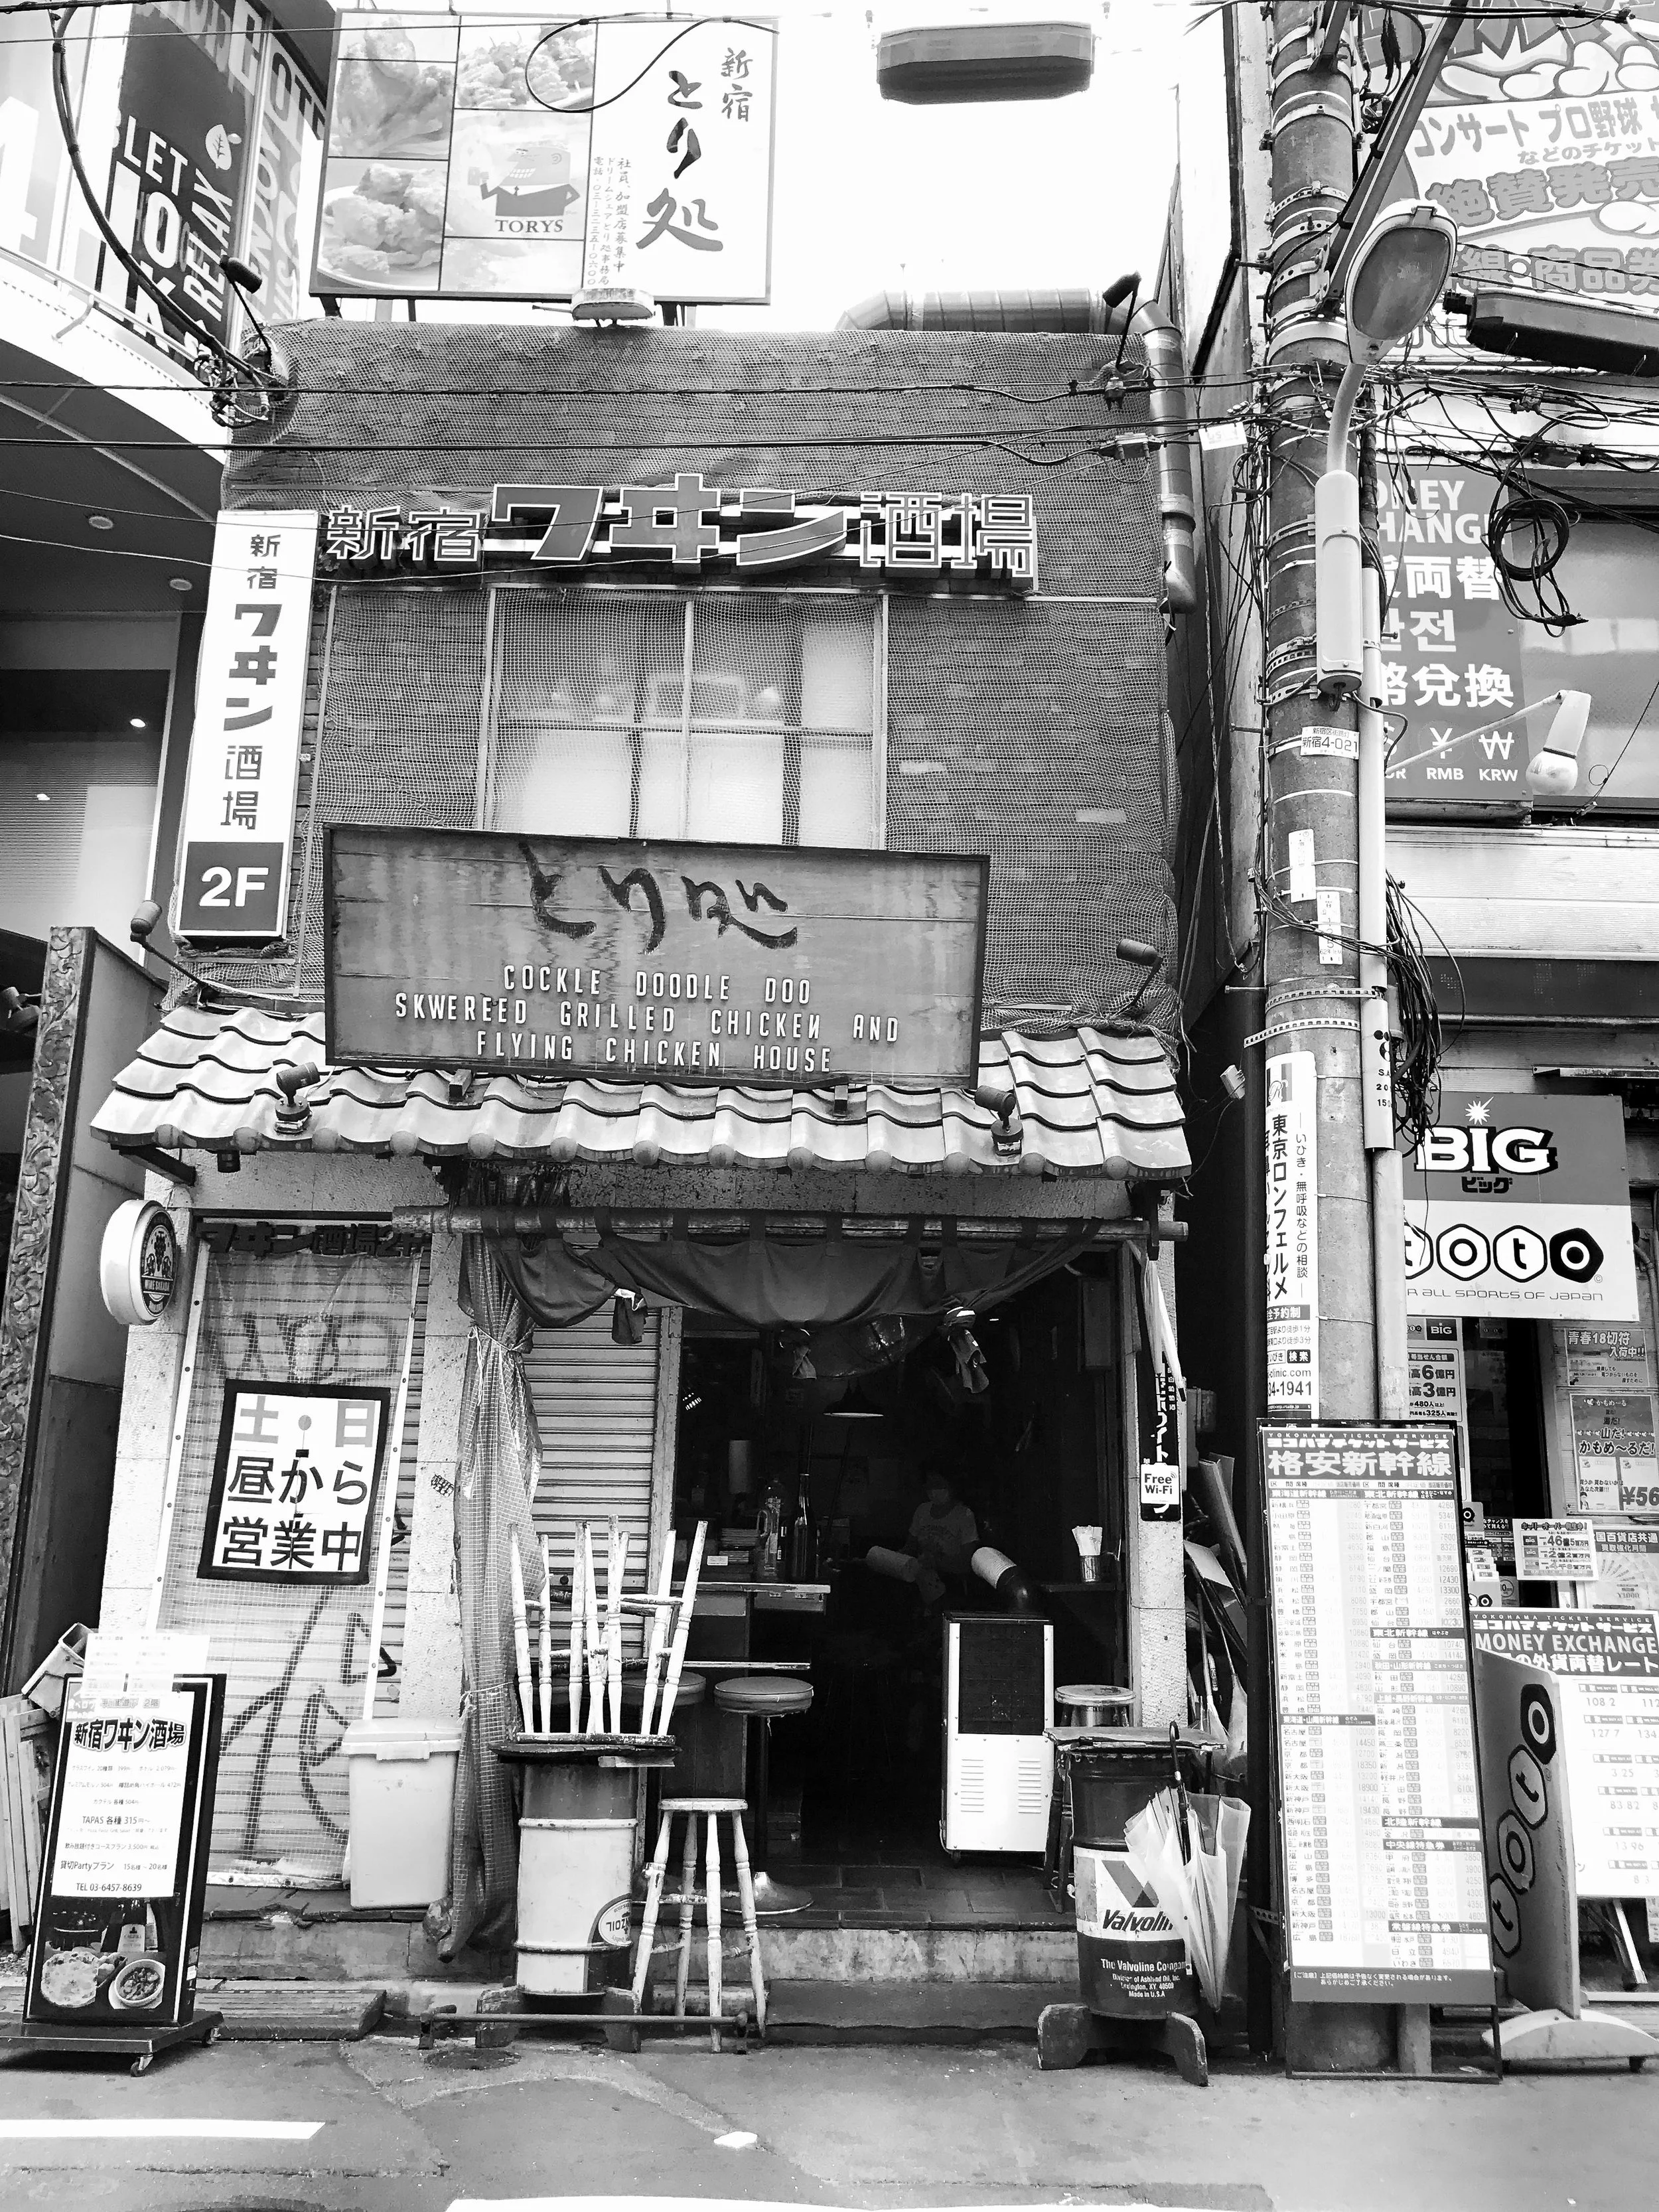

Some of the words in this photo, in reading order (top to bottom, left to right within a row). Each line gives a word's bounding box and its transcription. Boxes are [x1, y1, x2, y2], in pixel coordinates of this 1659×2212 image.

[721, 48, 753, 121] 新宿
[1539, 97, 1642, 143] プロ野球
[1413, 109, 1529, 157] コンサート
[124, 115, 187, 195] LET
[636, 70, 723, 252] とり処
[496, 219, 563, 234] TORYS
[183, 169, 233, 321] RELAX
[327, 473, 1033, 577] 新宿ワヰン酒場
[220, 534, 282, 830] 新宿ワヰン酒場
[1302, 736, 1358, 753] 新宿4-021
[1427, 767, 1464, 780] RMB
[1479, 769, 1518, 781] KRW
[199, 866, 269, 908] 2F
[503, 964, 601, 995] COCKLE
[636, 970, 730, 1001] DOODLE
[764, 977, 811, 1005] DOO
[396, 992, 528, 1025] SKWEREED
[559, 1001, 675, 1033] GRILLED
[853, 1015, 899, 1043] AND
[477, 1030, 573, 1061] FLYING
[605, 1037, 721, 1068] CHICKEN
[753, 1044, 831, 1073] HOUSE
[1413, 1124, 1558, 1175] BIG
[1461, 1176, 1513, 1193] ビッグ
[1271, 1113, 1289, 1300] 東京ロンフェルメ
[1524, 1291, 1546, 1299] OF
[1430, 1322, 1453, 1335] BIG
[1568, 1331, 1630, 1345] 青春18切符
[1609, 1346, 1645, 1358] 入荷中!!
[1408, 1364, 1455, 1380] 高6億円
[1409, 1382, 1457, 1398] 高3億円
[234, 1395, 376, 1447] 土・日
[1601, 1427, 1625, 1439] 山だ!
[1267, 1450, 1453, 1477] 格安新幹線
[228, 1455, 368, 1505] 昼から
[1145, 1473, 1172, 1484] Free
[1145, 1484, 1173, 1495] Wi-Fi
[1271, 1489, 1327, 1498] 東海道新幹線
[1364, 1490, 1419, 1499] 東北新幹線
[222, 1516, 362, 1571] 営業中
[1594, 1531, 1658, 1544] 国百貨店共通
[1372, 1629, 1428, 1637] 東北新幹線
[1475, 1633, 1545, 1652] MONEY
[1551, 1634, 1659, 1654] EXCHANGE
[82, 1816, 104, 1824] TAPAS
[106, 1816, 122, 1824] 各種
[1384, 1818, 1442, 1827] 北陸新幹線
[76, 1883, 88, 1891] TEL
[90, 1883, 142, 1891] 03-6457-8639
[1102, 1909, 1174, 1932] Valvolin
[1117, 1960, 1155, 1972] Valvoline
[1157, 1961, 1187, 1972] Compan
